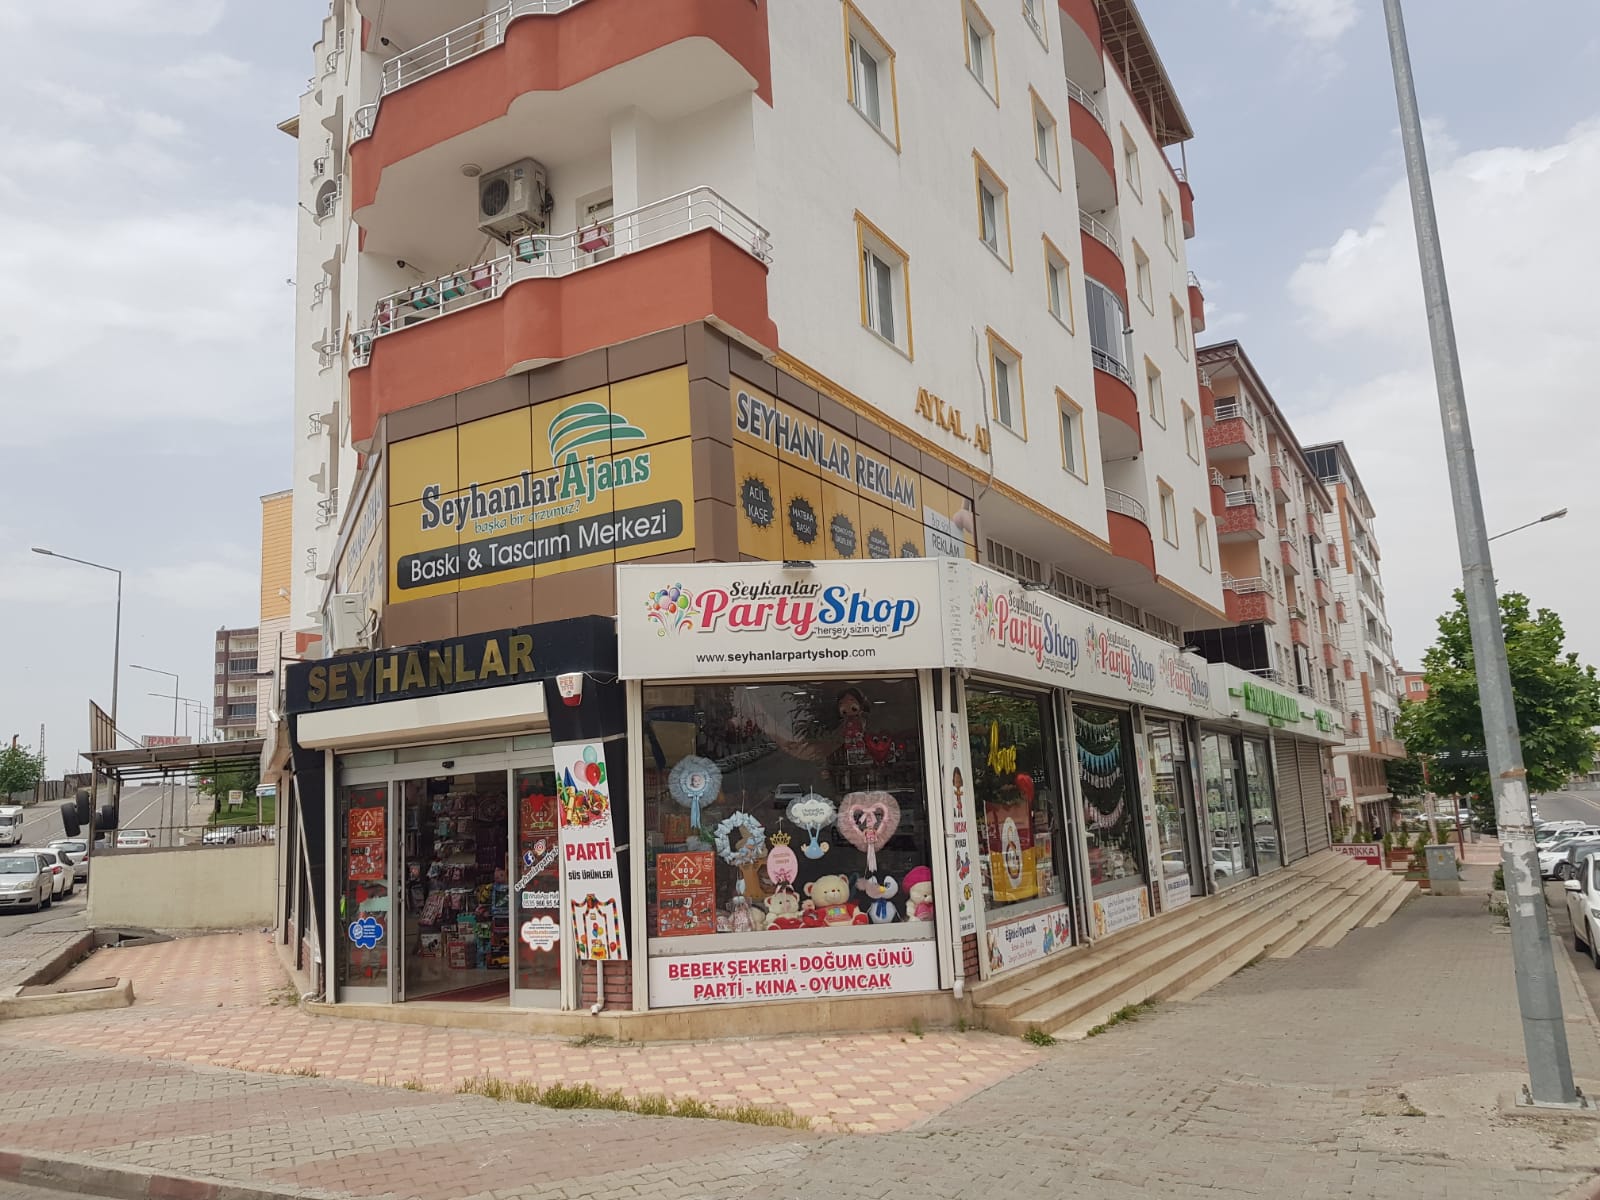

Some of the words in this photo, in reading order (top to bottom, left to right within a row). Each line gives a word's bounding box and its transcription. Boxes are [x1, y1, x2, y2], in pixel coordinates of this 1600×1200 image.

[737, 391, 851, 479] SEYHANLAR
[855, 453, 916, 511] REKLAM
[474, 519, 507, 534] başka
[510, 514, 526, 526] bir
[528, 500, 581, 525] arzunuz?
[748, 504, 769, 524] KAŞE
[411, 551, 460, 582] Baskı
[468, 548, 483, 571] &
[489, 533, 570, 567] Tasarım
[579, 508, 667, 550] Merkezi
[730, 580, 819, 601] Seyhanlar
[849, 625, 870, 634] sizin
[307, 633, 535, 704] SEYHANLAR
[696, 648, 876, 664] www.seyhanlarpartyshop.com
[565, 837, 612, 862] PARTİ
[568, 870, 581, 881] SÜS
[581, 867, 614, 880] ÜRÜNLERİ
[668, 961, 724, 980] BEBEK
[727, 954, 787, 980] ŞEKERİ
[799, 950, 863, 971] DOĞUM
[865, 947, 914, 967] GÜNÜ
[694, 978, 743, 999] PARTİ
[755, 976, 798, 996] KINA
[809, 972, 892, 992] OYUNCAK
